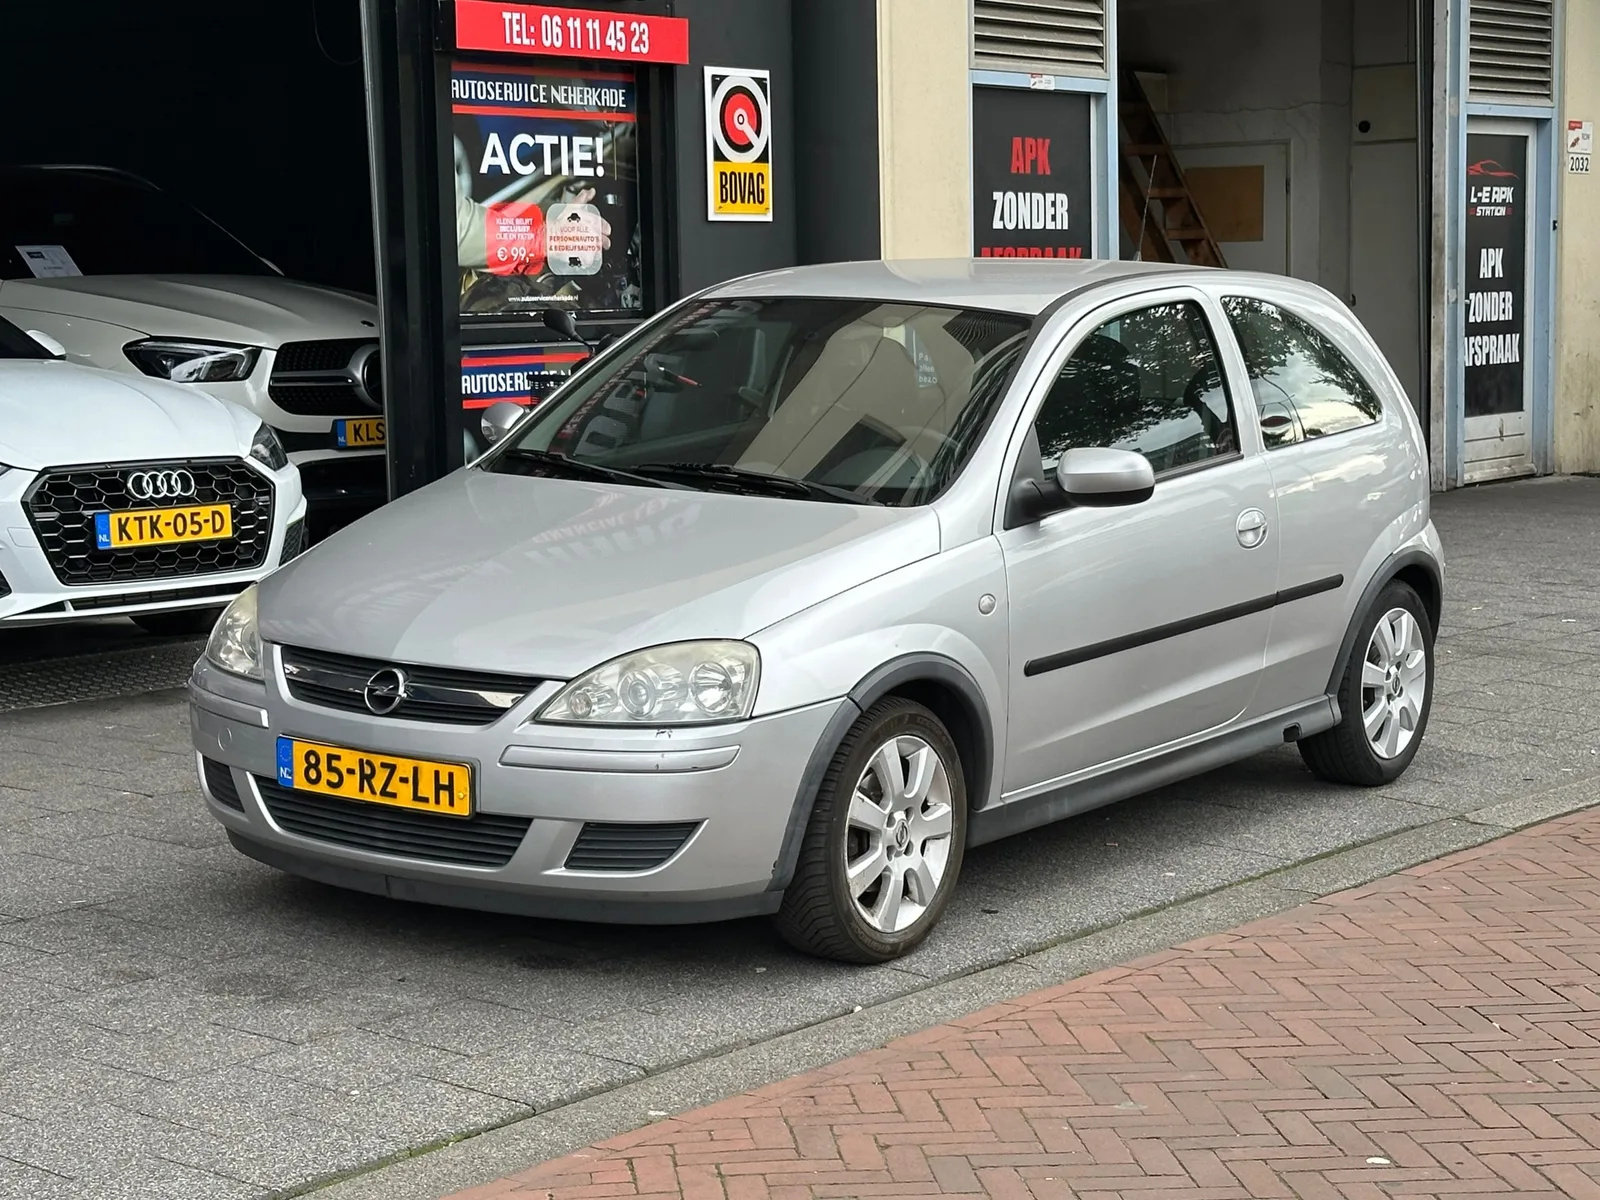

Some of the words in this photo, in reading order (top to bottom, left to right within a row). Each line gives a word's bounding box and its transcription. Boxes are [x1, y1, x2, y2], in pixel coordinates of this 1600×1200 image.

[502, 11, 535, 46] TEL:
[541, 14, 563, 48] 06
[566, 17, 582, 49] 11
[586, 18, 600, 50] 11
[605, 20, 626, 53] 45
[630, 21, 649, 54] 23
[451, 78, 547, 103] AUTOSERVICE
[551, 85, 626, 108] NEHERKADE
[479, 133, 605, 177] ACTIE!
[1011, 137, 1050, 175] APK
[1570, 156, 1589, 172] 2032
[719, 171, 765, 205] BOVAG
[1491, 186, 1514, 204] APK
[993, 191, 1069, 230] ZONDER
[1476, 206, 1506, 217] STATION
[511, 247, 535, 263] 99,-
[1479, 248, 1503, 279] APK
[1468, 290, 1513, 323] ZONDER
[1464, 333, 1520, 367] AFSPRAAK
[353, 421, 385, 442] KLS
[99, 532, 110, 544] NL
[117, 511, 225, 542] KTK-05-D
[280, 766, 292, 780] NL
[303, 749, 455, 807] 85-RZ-LH
